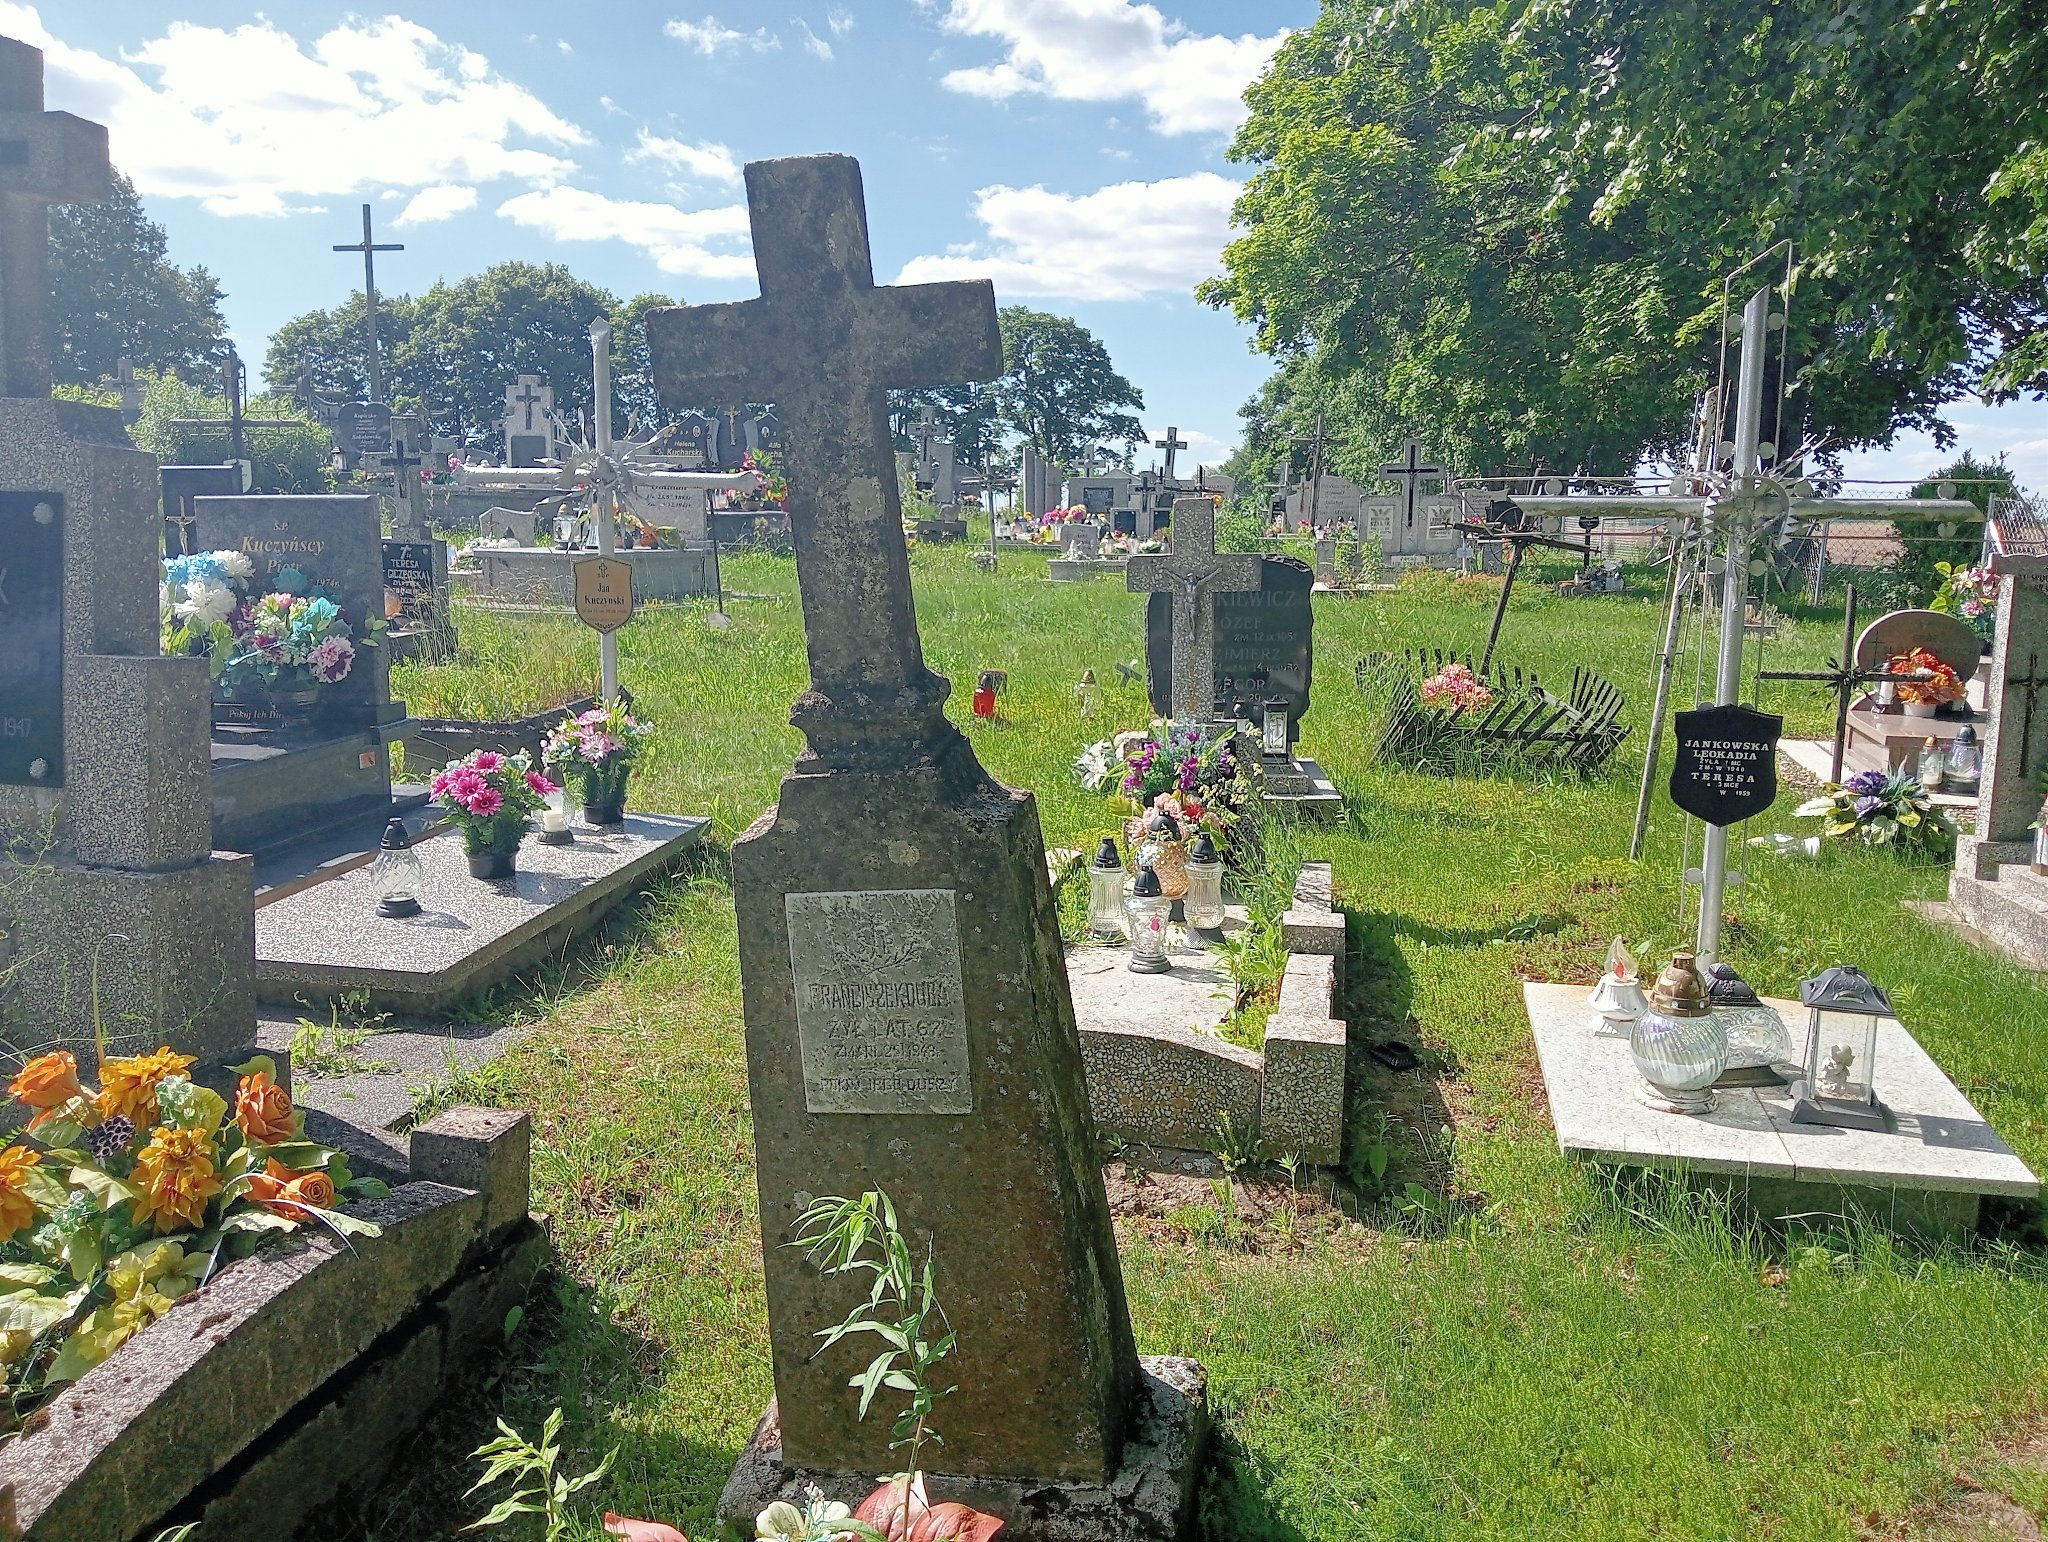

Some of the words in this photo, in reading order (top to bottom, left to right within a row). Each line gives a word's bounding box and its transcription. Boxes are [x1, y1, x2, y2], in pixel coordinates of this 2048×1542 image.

[241, 536, 325, 555] Kuczyńscy
[391, 559, 420, 569] TERESA
[598, 583, 610, 592] Jan
[1217, 591, 1296, 607] KIEWICZ
[1685, 740, 1769, 751] JANKOWSKA
[1693, 750, 1757, 760] LEOKADIA
[1691, 772, 1754, 782] TERESA
